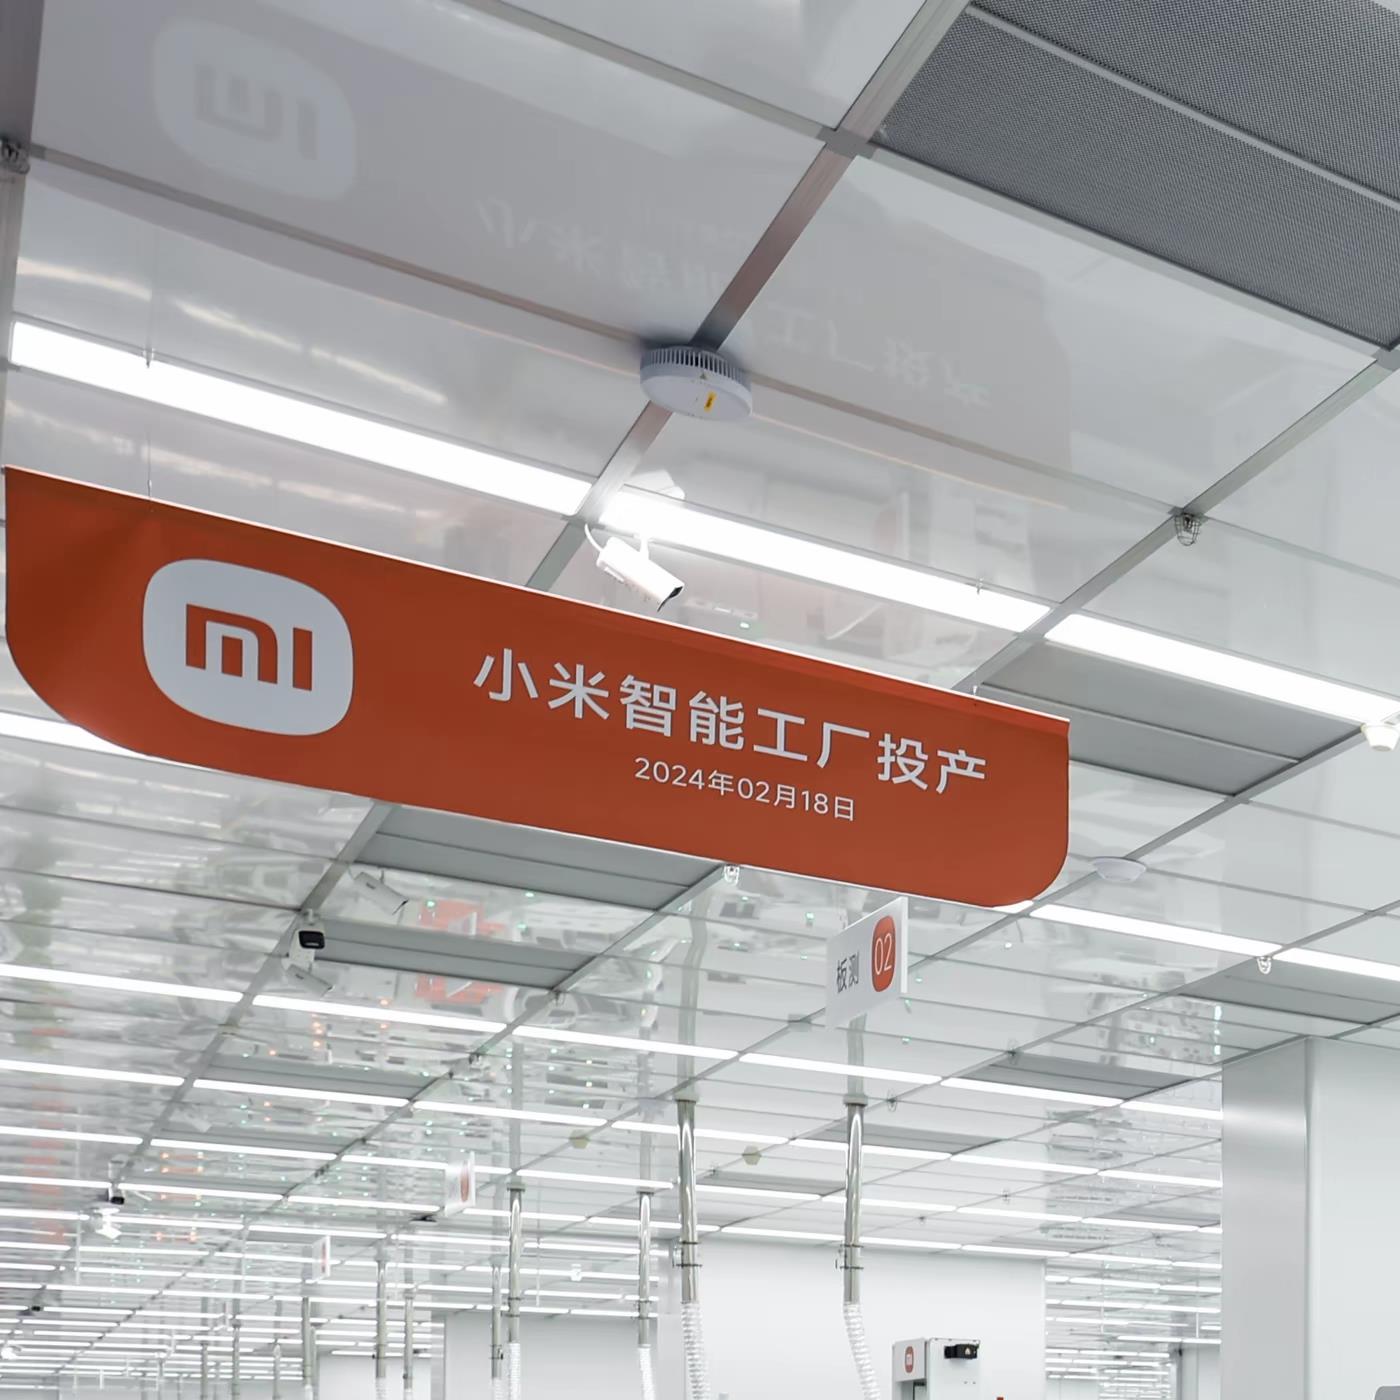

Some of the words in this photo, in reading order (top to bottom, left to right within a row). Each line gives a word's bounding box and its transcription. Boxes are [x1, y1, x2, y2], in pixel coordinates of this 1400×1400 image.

[472, 648, 987, 796] 小米智能工厂投产
[633, 757, 857, 823] 2024年02月18日
[874, 932, 893, 976] 02
